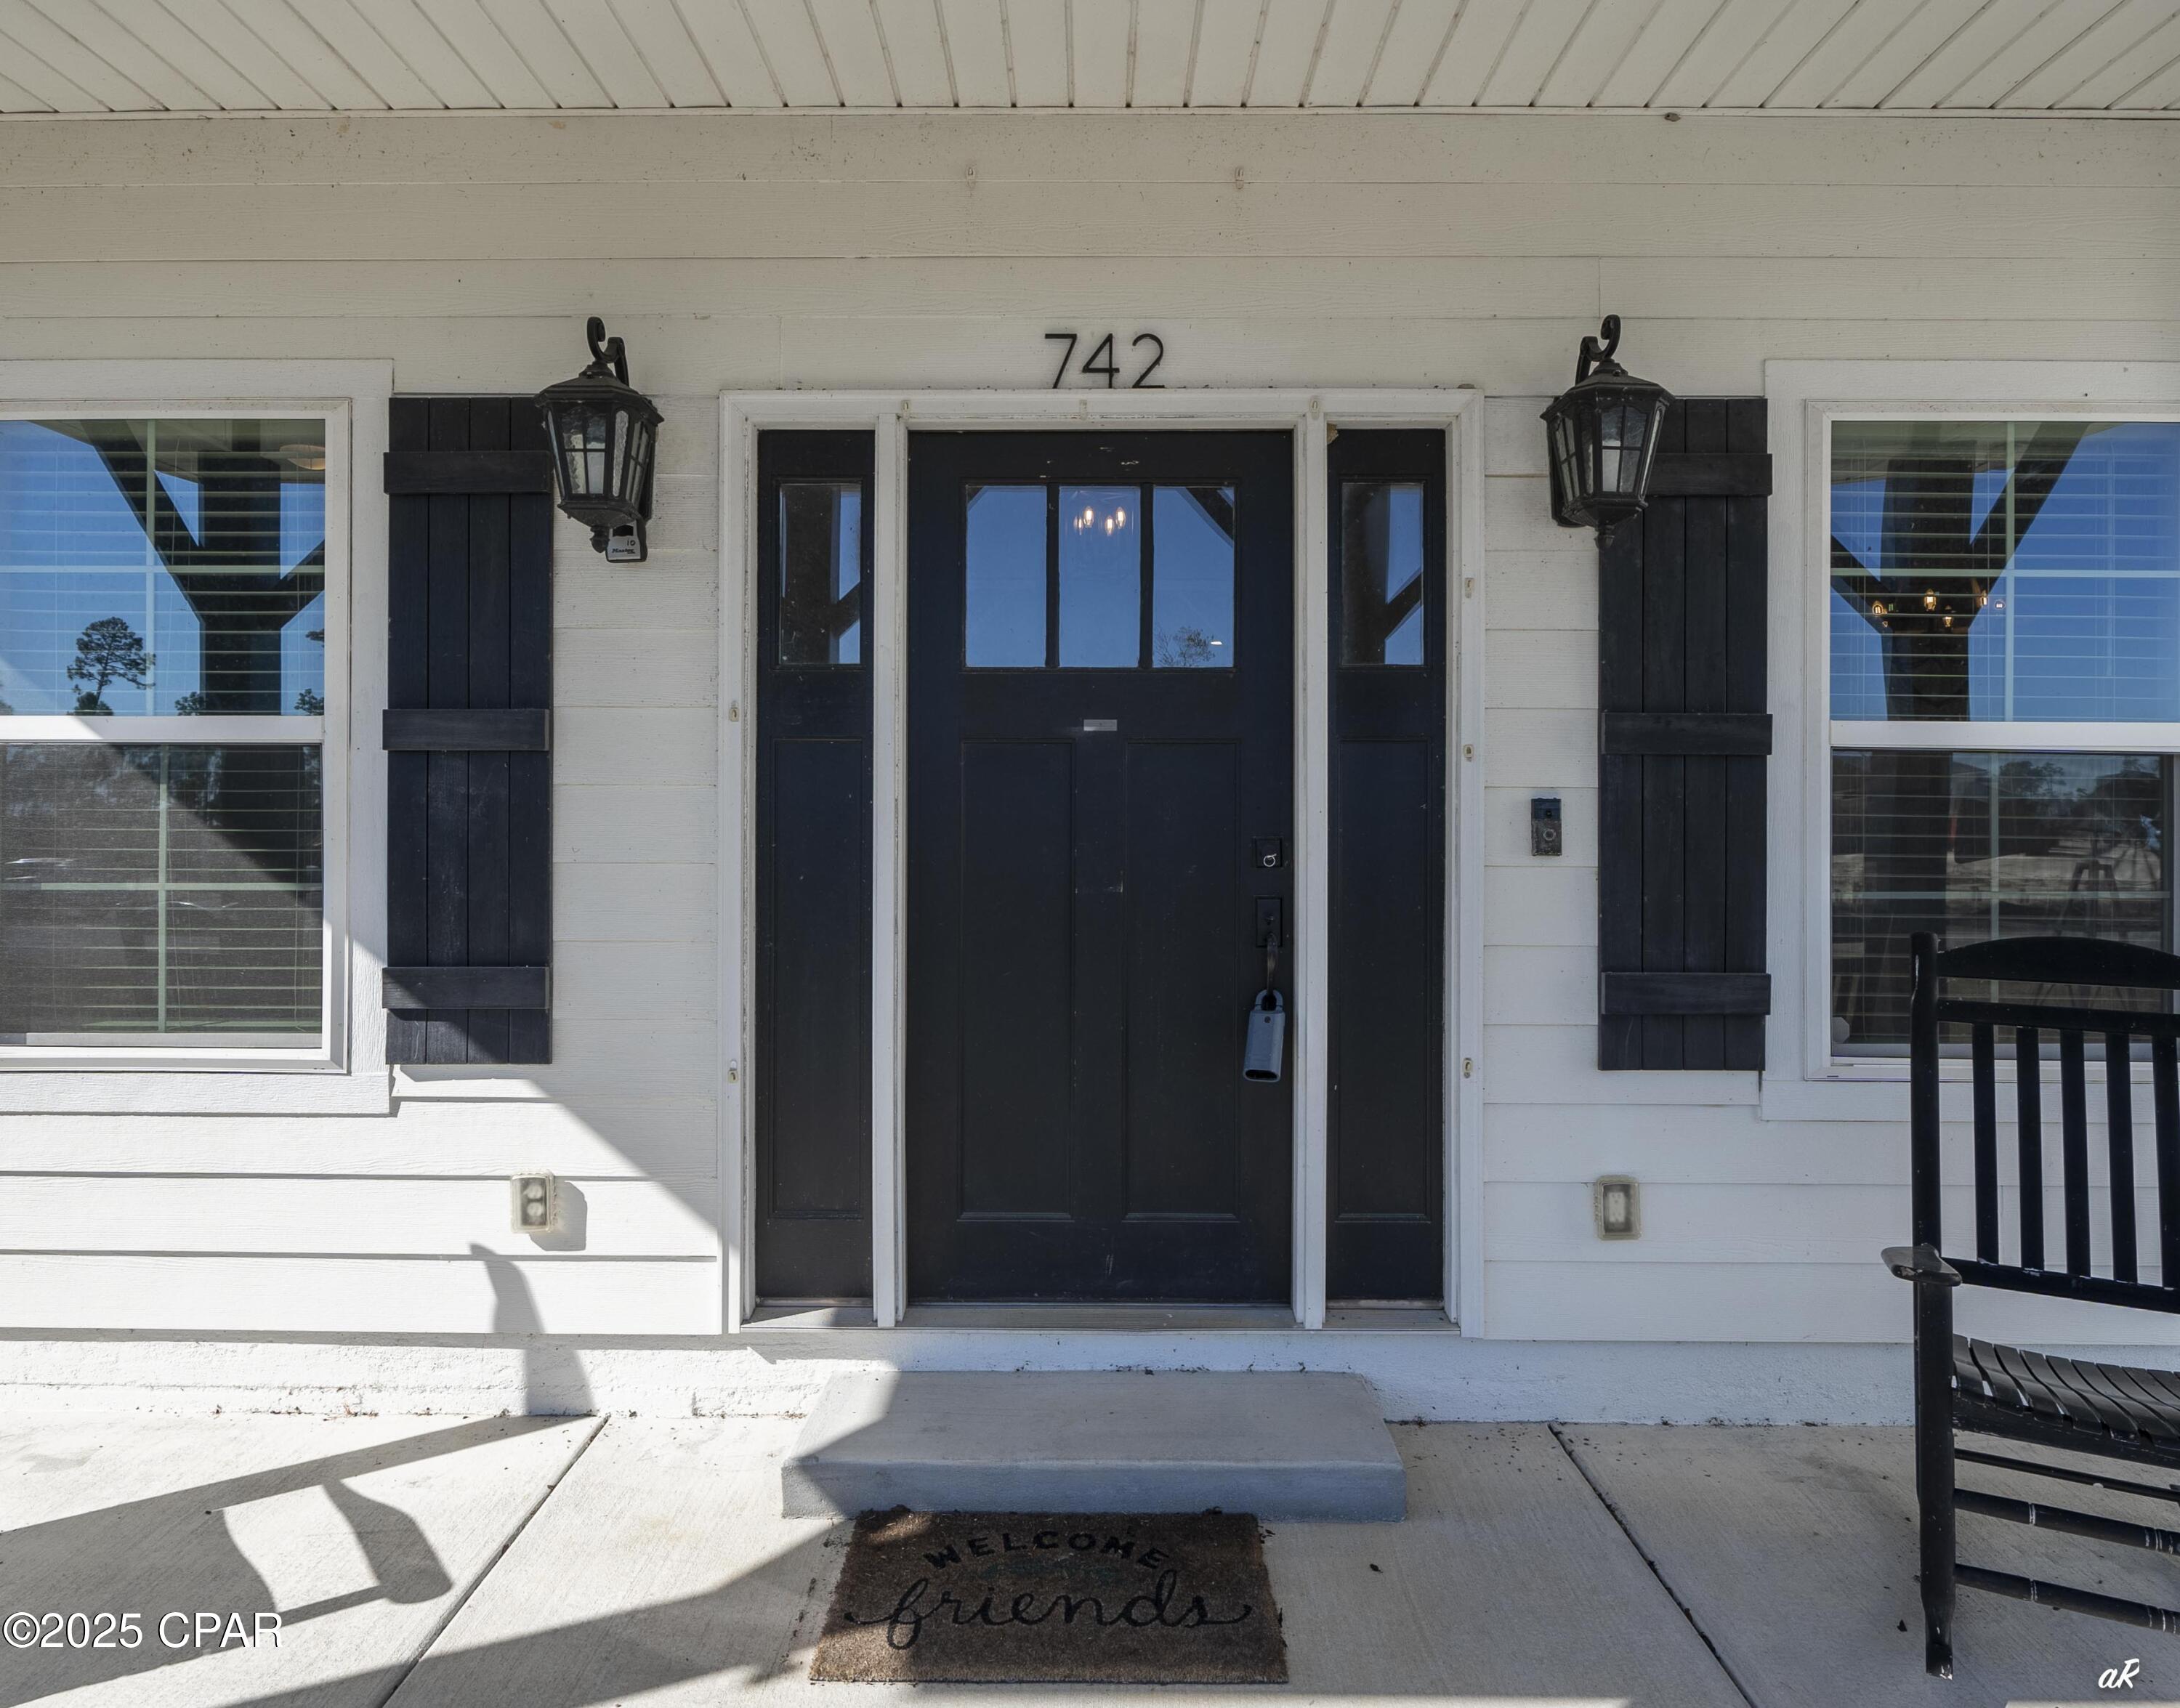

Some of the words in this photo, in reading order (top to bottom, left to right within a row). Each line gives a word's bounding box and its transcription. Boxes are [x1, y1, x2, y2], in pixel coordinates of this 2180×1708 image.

[1044, 333, 1166, 389] 742
[924, 1531, 1170, 1571] WELCOME
[844, 1569, 1252, 1651] friends
